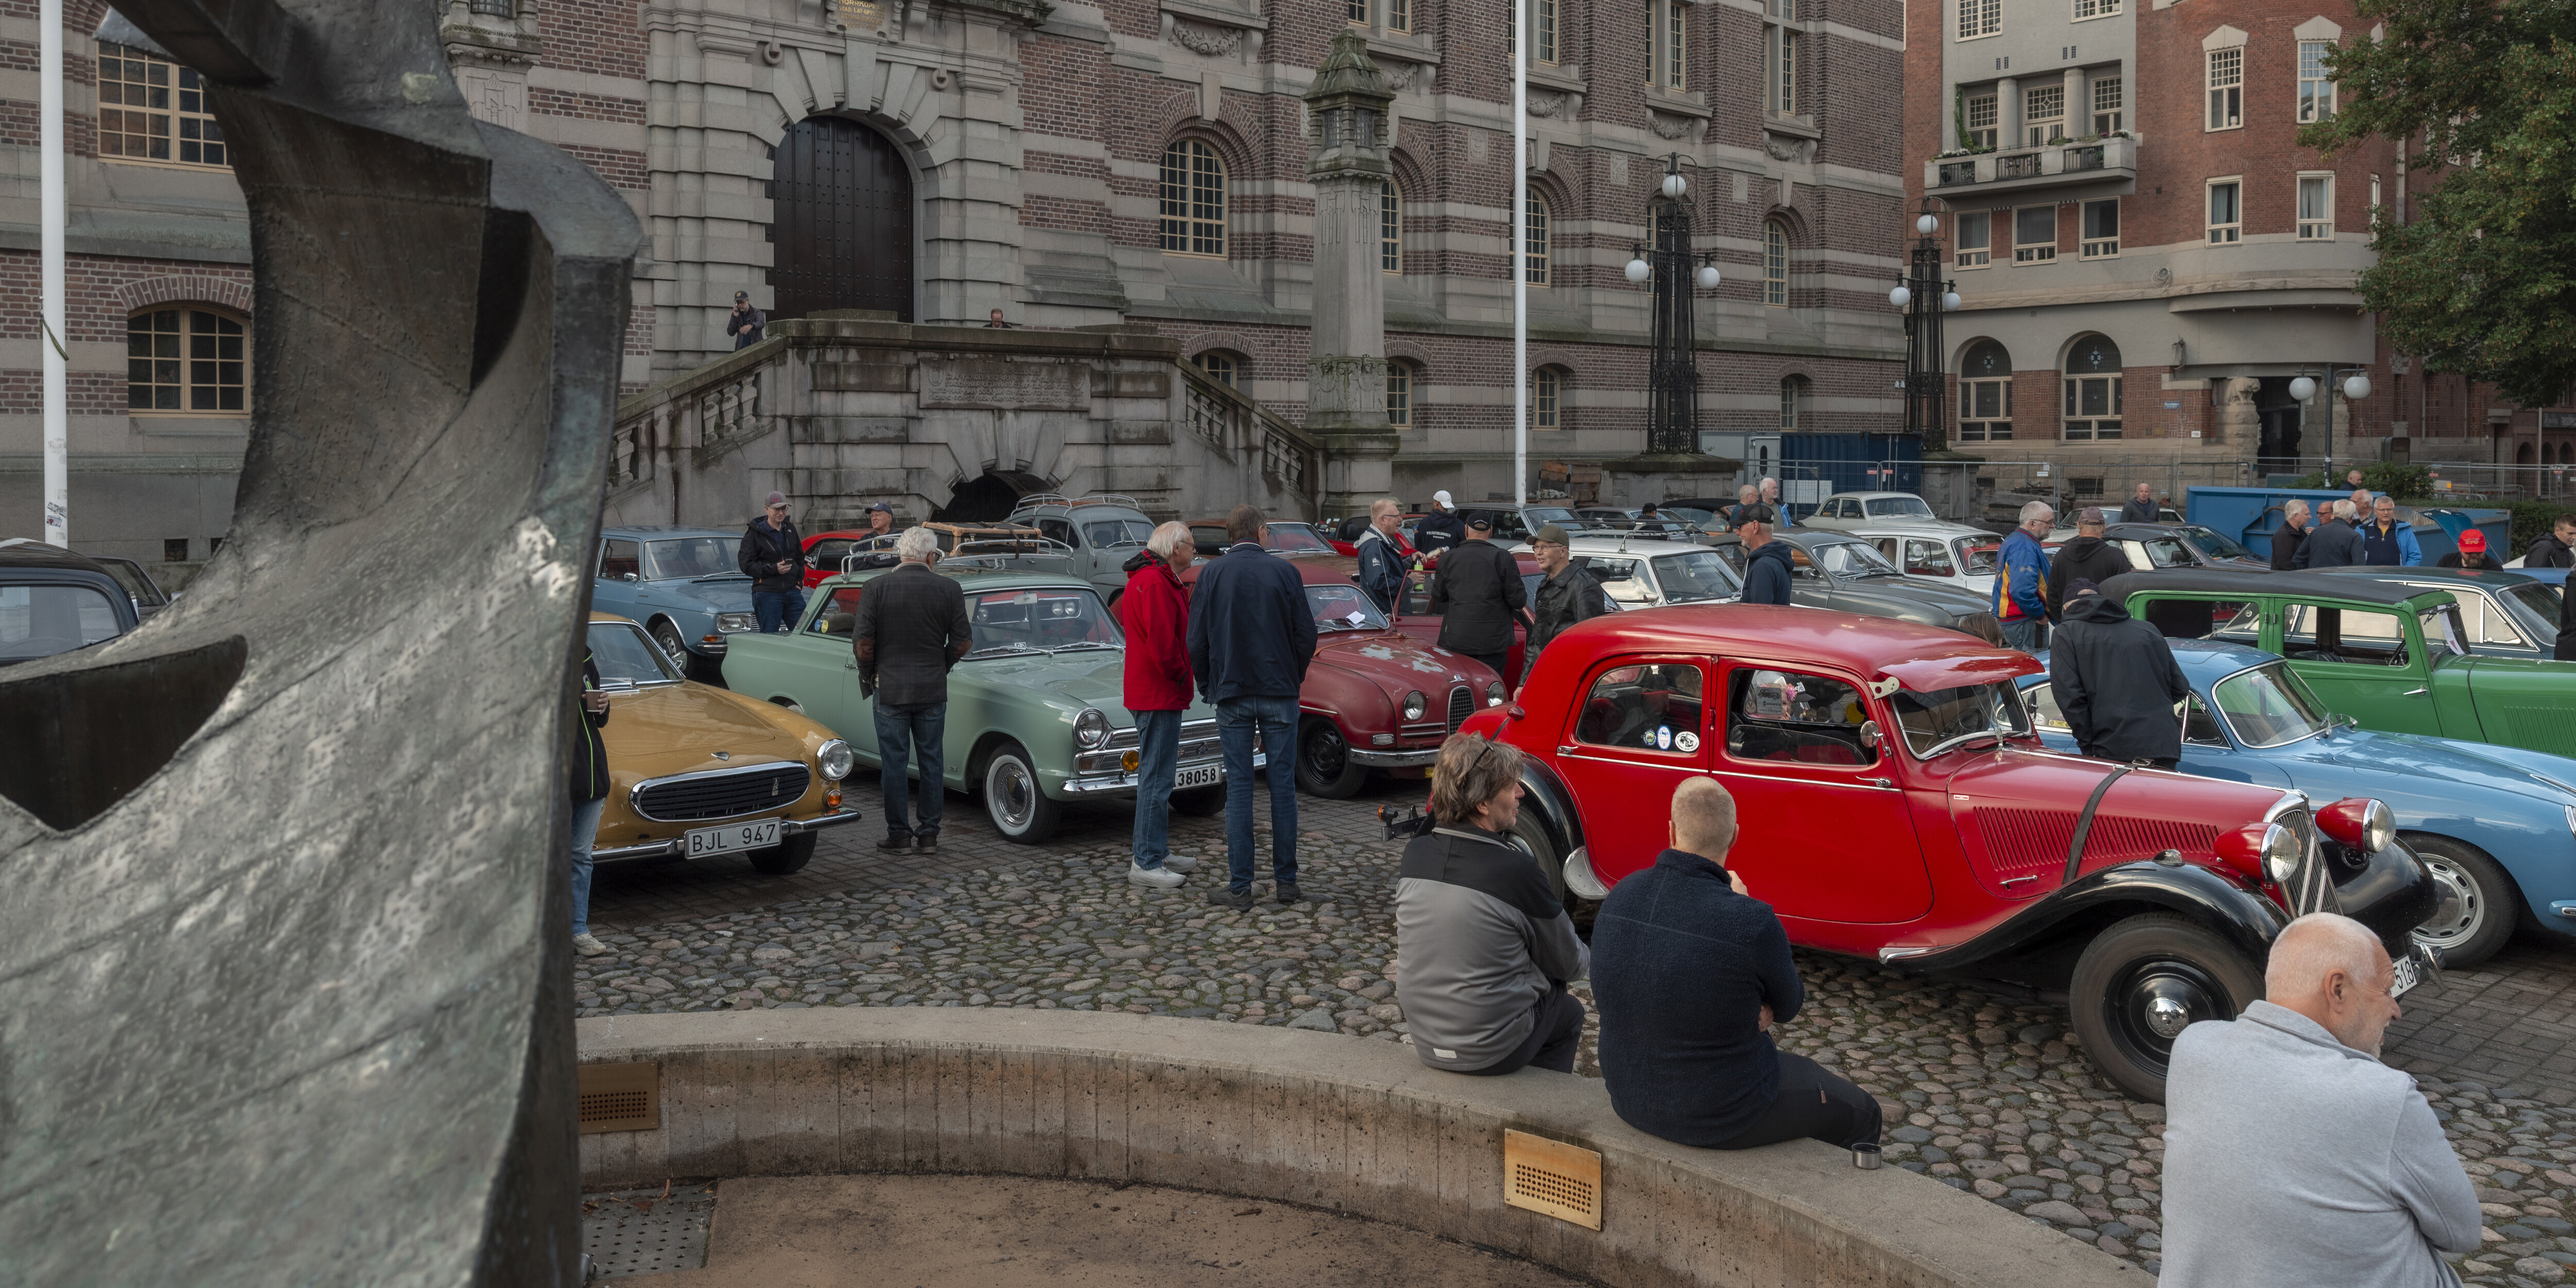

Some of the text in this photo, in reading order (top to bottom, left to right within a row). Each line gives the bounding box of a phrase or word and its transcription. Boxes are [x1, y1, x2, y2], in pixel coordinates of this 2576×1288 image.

[1174, 768, 1216, 787] 38058
[693, 824, 776, 852] BJL 947
[2394, 960, 2414, 989] 518
